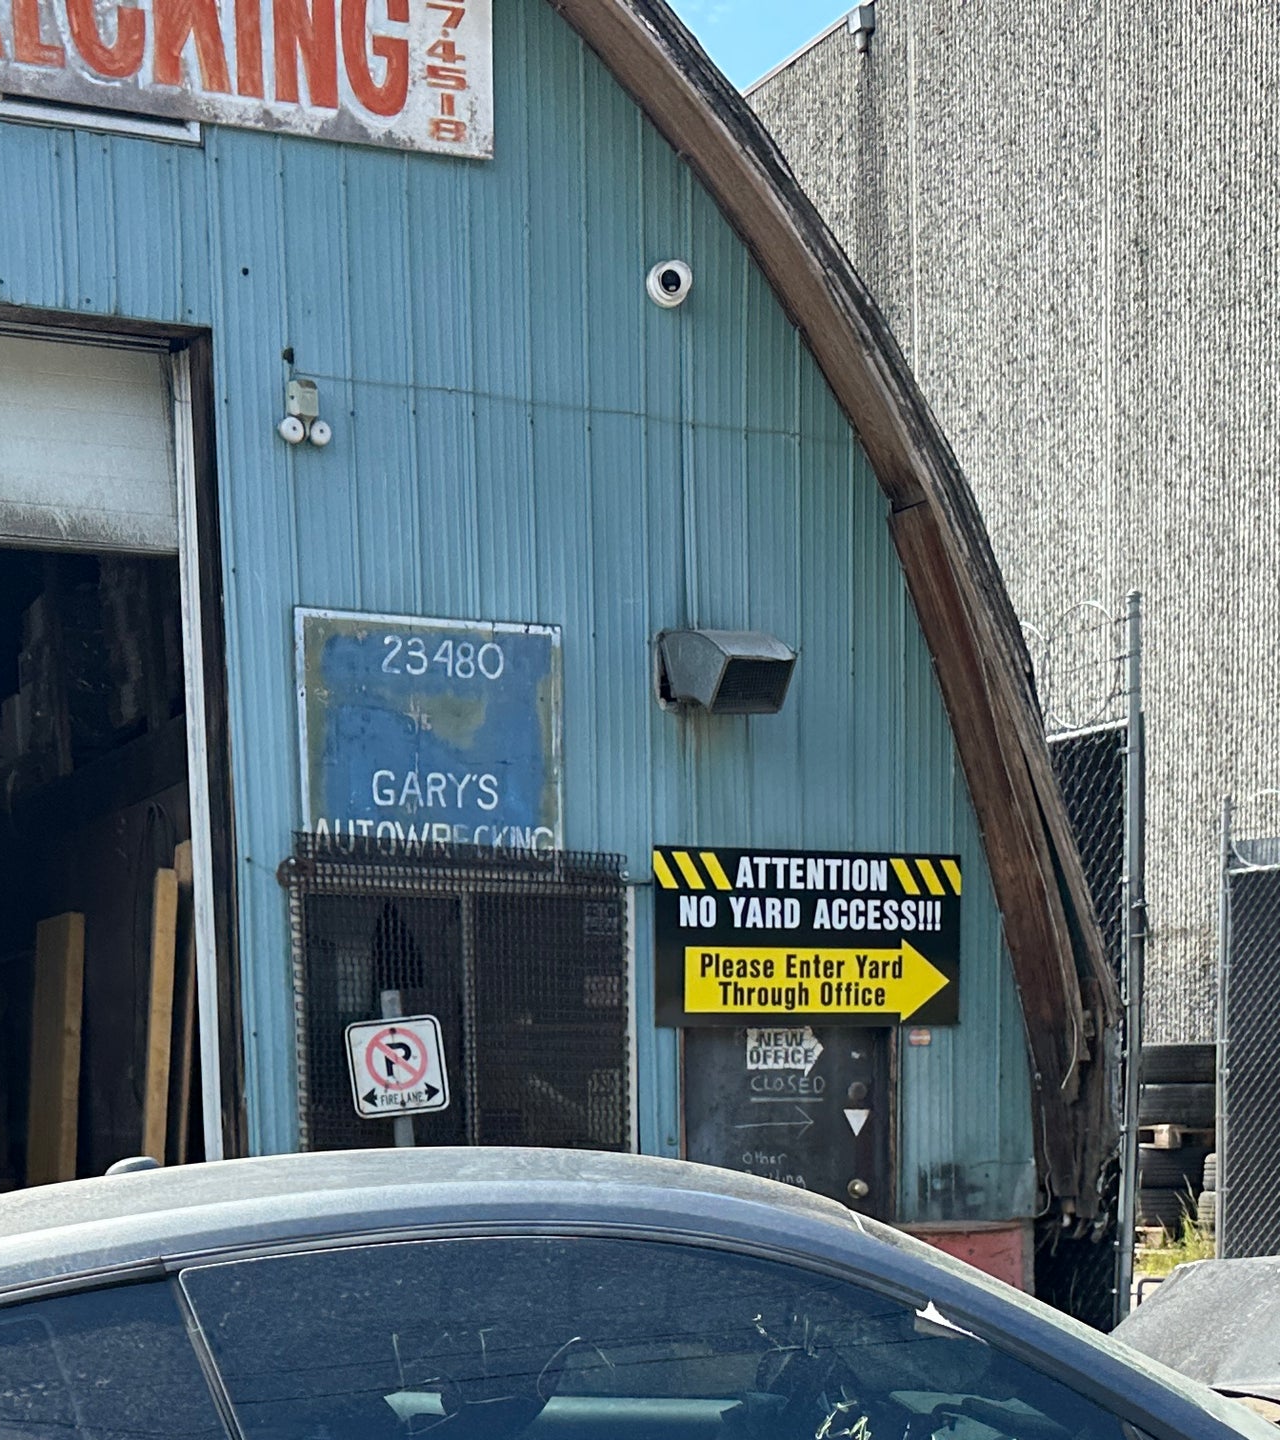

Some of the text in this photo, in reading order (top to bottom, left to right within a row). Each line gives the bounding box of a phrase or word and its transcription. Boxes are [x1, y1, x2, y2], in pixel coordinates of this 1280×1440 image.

[381, 635, 504, 680] 23480
[372, 769, 499, 811] GARY'S
[735, 856, 888, 892] ATTENTION
[679, 896, 941, 931] NO YARD ACCESS!!!
[700, 953, 903, 980] Please Enter Yard
[719, 981, 885, 1010] Through Office
[749, 1032, 814, 1065] NEW OFFICE
[380, 1090, 424, 1106] FIRE LANE
[750, 1075, 825, 1094] CLOSED
